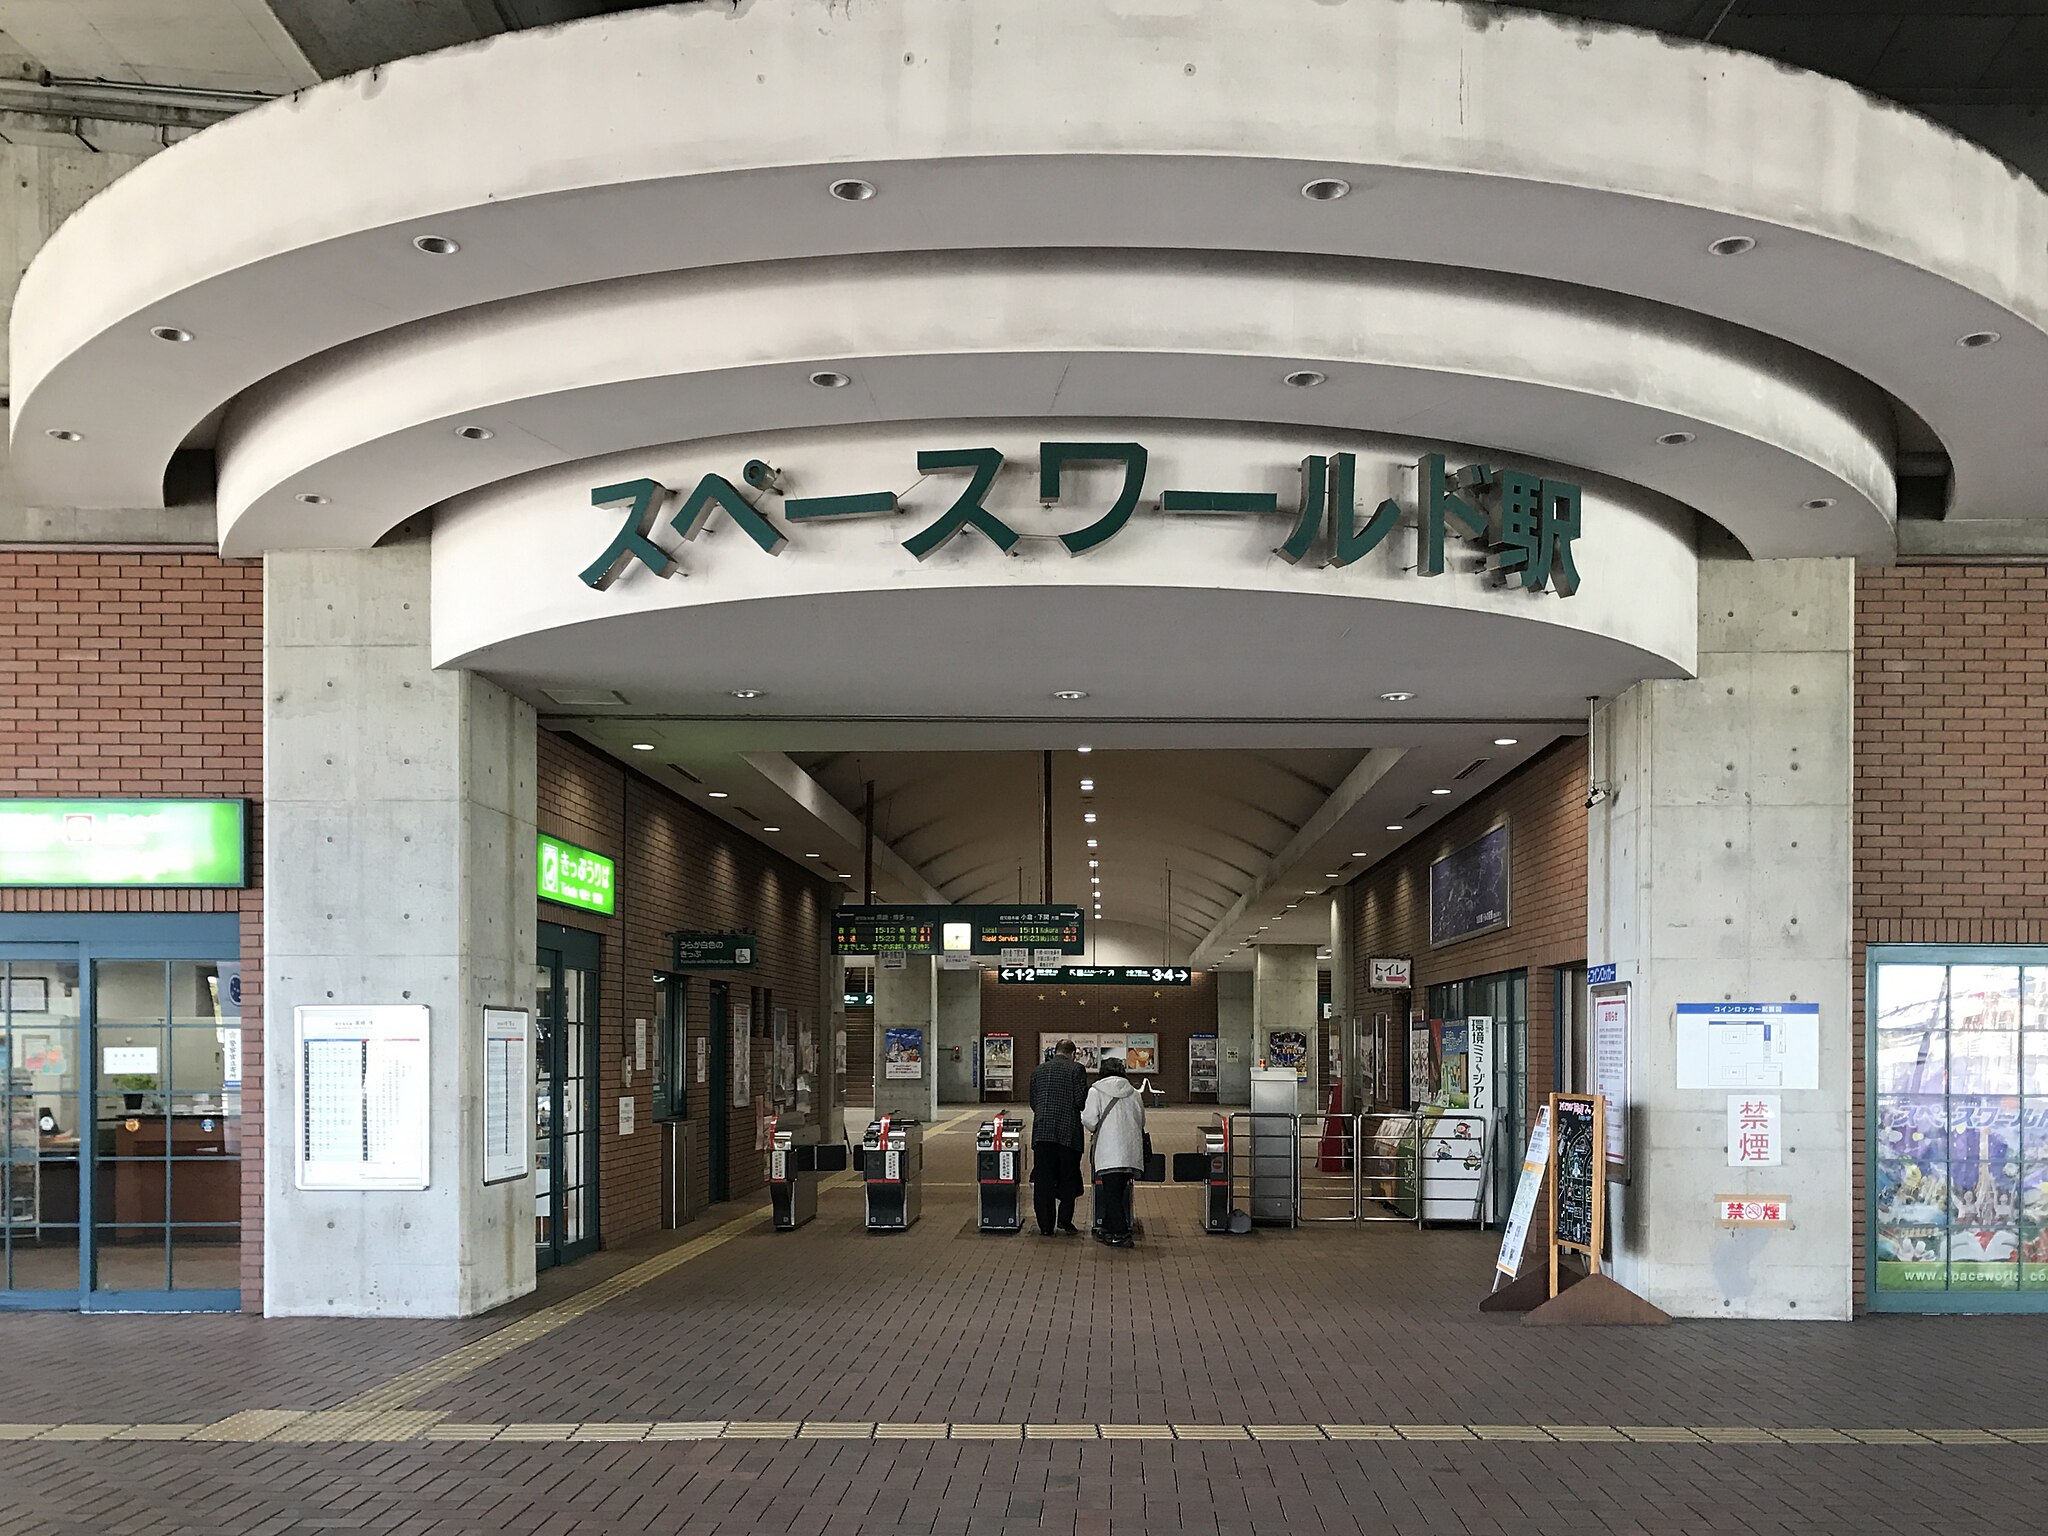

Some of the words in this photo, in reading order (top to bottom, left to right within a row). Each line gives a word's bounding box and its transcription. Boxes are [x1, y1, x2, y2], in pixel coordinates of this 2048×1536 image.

[578, 441, 1581, 599] スペースワールド駅
[560, 851, 610, 889] きっぷうりば
[1020, 913, 1050, 921] 小倉・下関
[680, 941, 724, 949] うらが白色の
[680, 950, 702, 958] きっぷ
[1375, 963, 1406, 976] トイレ
[865, 994, 874, 1004] 2
[1738, 1100, 1770, 1162] 禁煙
